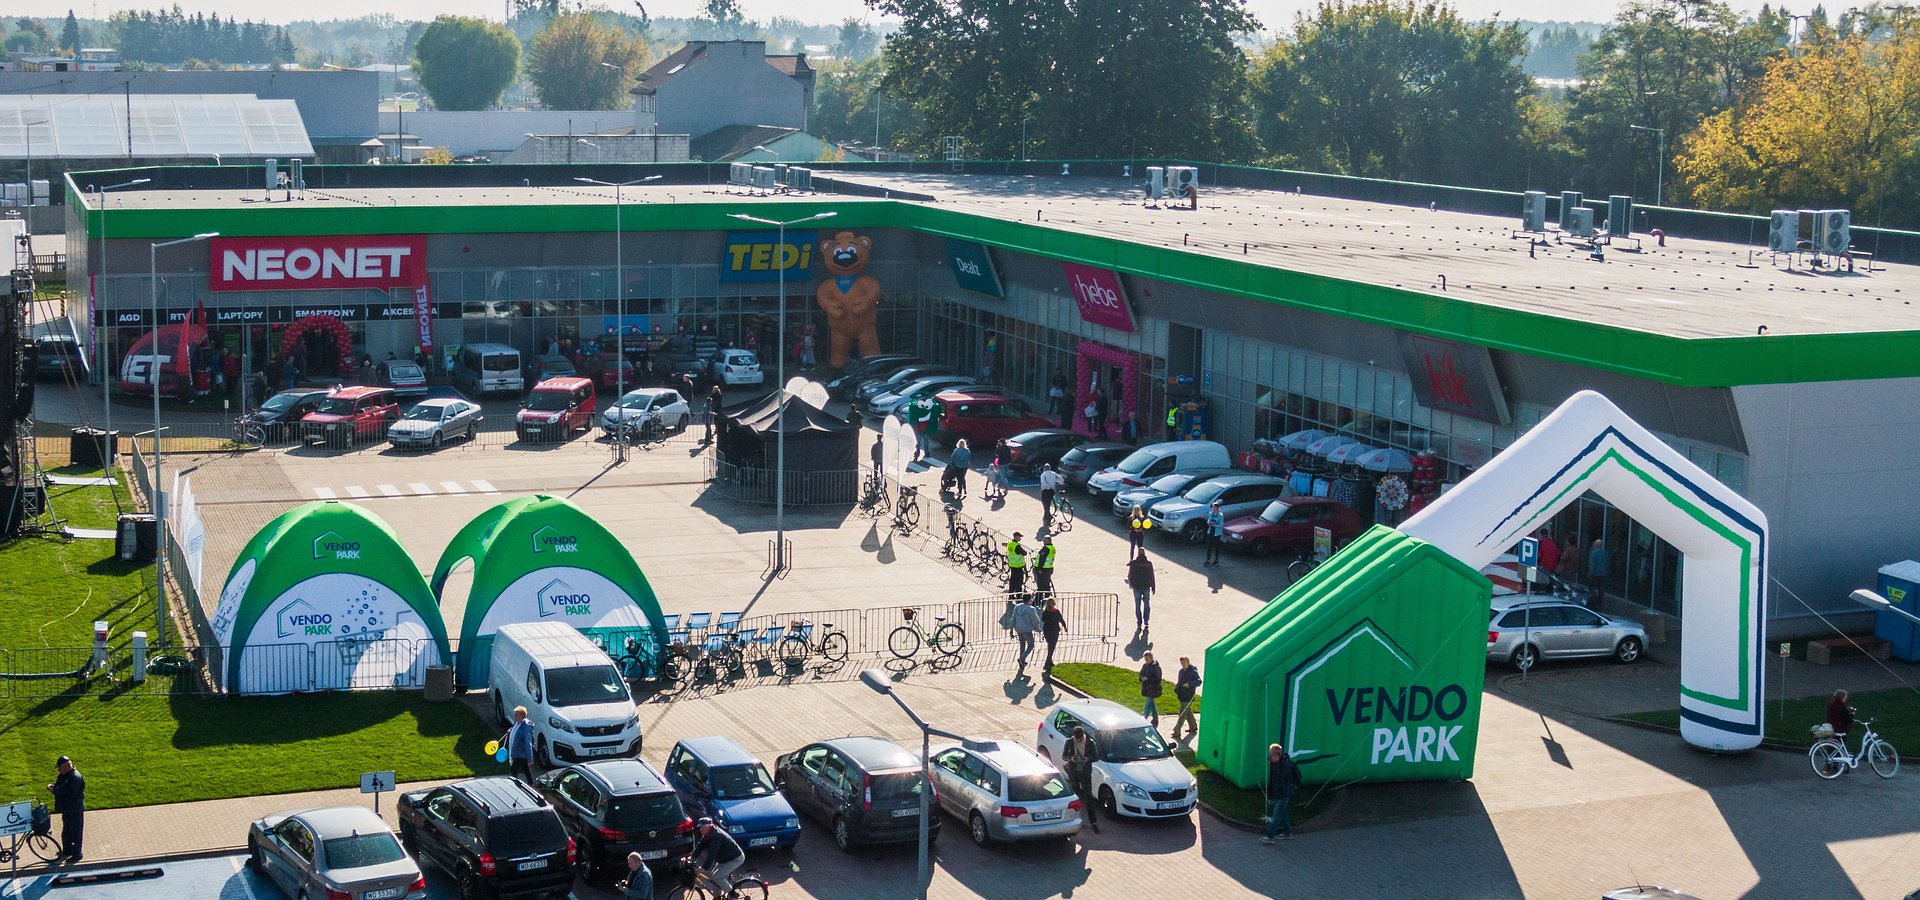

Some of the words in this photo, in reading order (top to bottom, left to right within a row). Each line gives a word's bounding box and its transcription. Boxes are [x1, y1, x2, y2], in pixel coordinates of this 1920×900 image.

[729, 243, 812, 271] TEDi
[223, 247, 411, 282] NEONET
[956, 257, 981, 276] Dealz
[1075, 274, 1119, 309] hebe
[119, 314, 141, 322] AGD
[218, 311, 263, 320] LAPTOPY
[323, 542, 360, 551] VENDO
[542, 535, 577, 545] VENDO
[336, 550, 361, 559] PARK
[555, 543, 578, 553] PARK
[1522, 541, 1534, 561] P
[550, 593, 591, 606] VENDO
[565, 604, 591, 616] PARK
[289, 613, 333, 626] VENDO
[304, 624, 333, 636] PARK
[1325, 684, 1468, 726] VENDO
[1371, 725, 1464, 765] PARK
